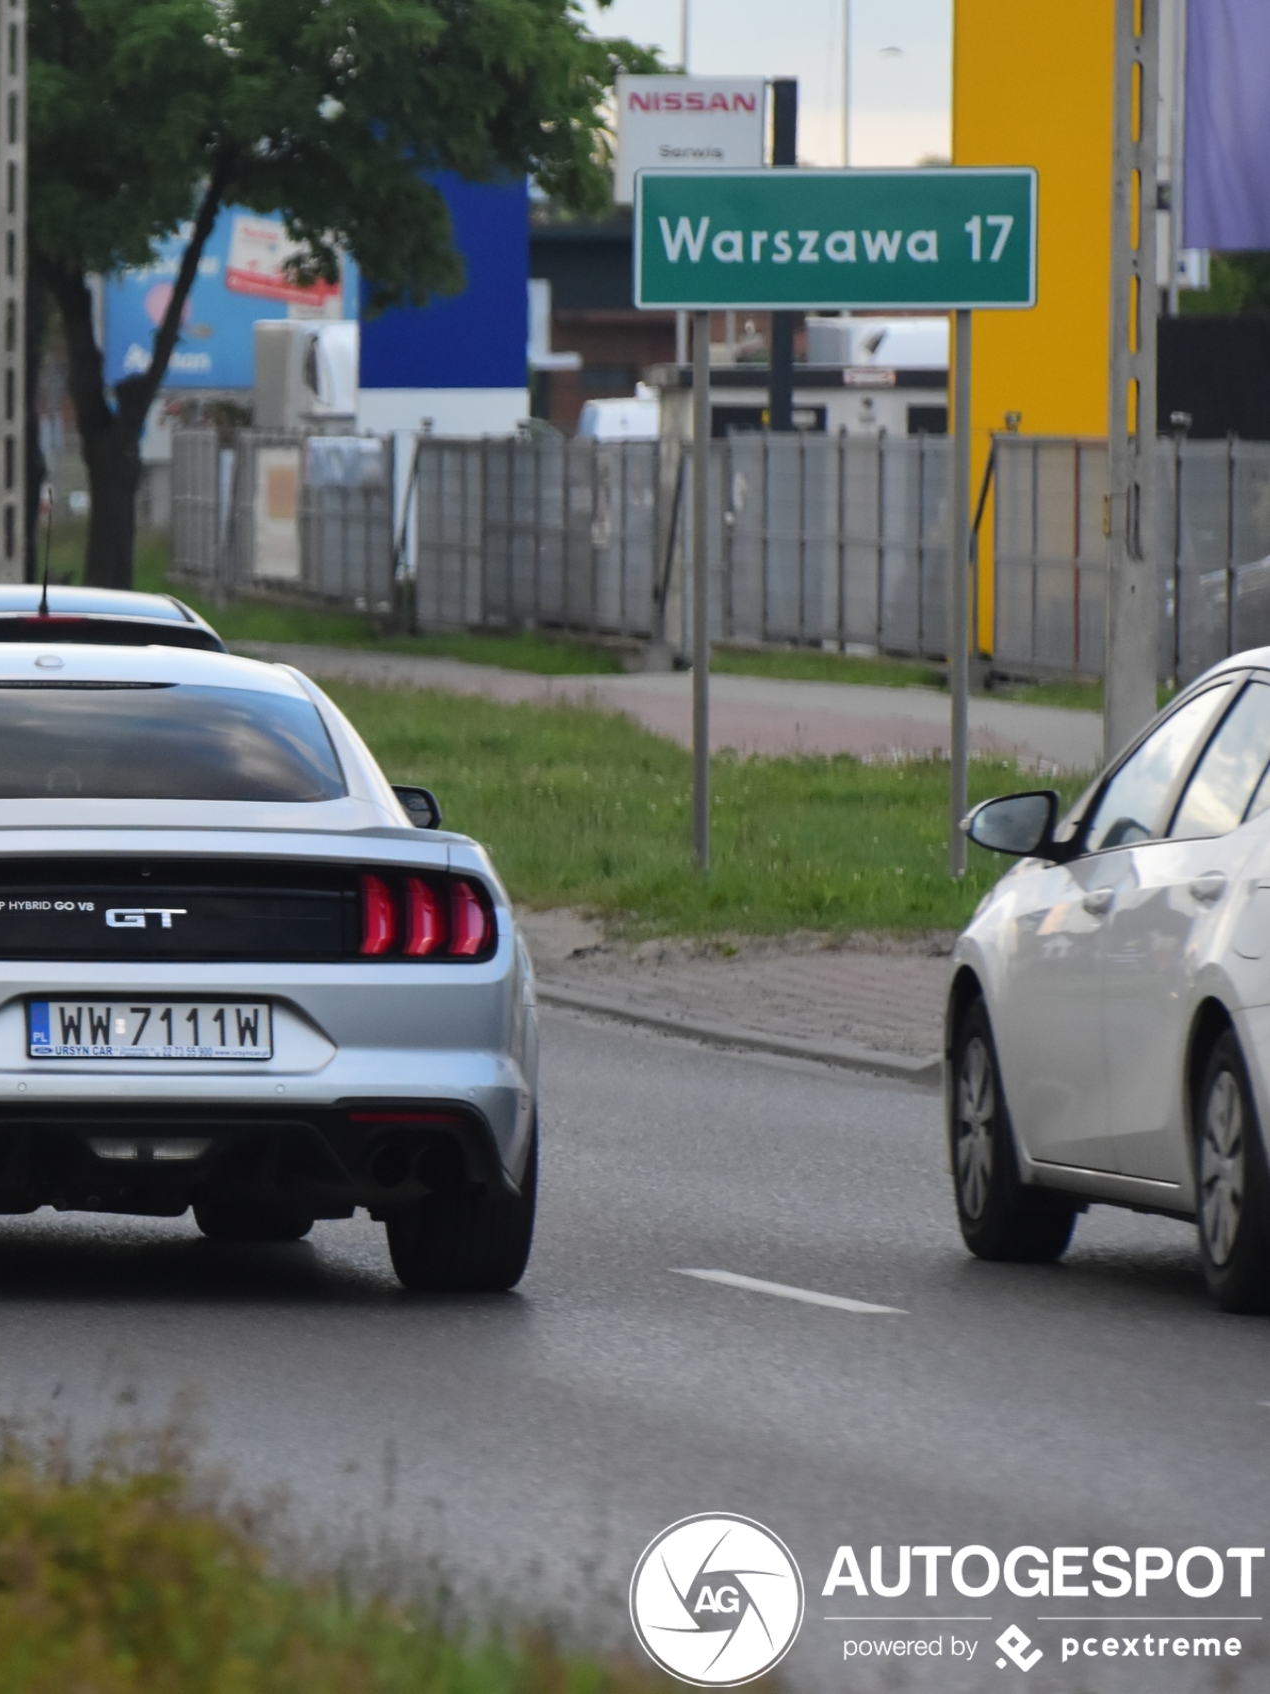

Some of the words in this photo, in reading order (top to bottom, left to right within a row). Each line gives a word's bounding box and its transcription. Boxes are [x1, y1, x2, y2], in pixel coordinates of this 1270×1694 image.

[629, 92, 756, 112] NISSAN
[659, 144, 722, 158] Serwis
[658, 216, 938, 263] Warszawa
[964, 215, 1014, 262] 17
[8, 901, 52, 911] HYBRID
[54, 901, 75, 911] GO
[78, 902, 95, 911] V8
[105, 908, 187, 928] GT
[59, 1007, 111, 1046] WW
[130, 1007, 259, 1047] 7111W
[33, 1032, 48, 1043] PL
[55, 1046, 89, 1056] URSYN
[92, 1047, 113, 1056] CAR
